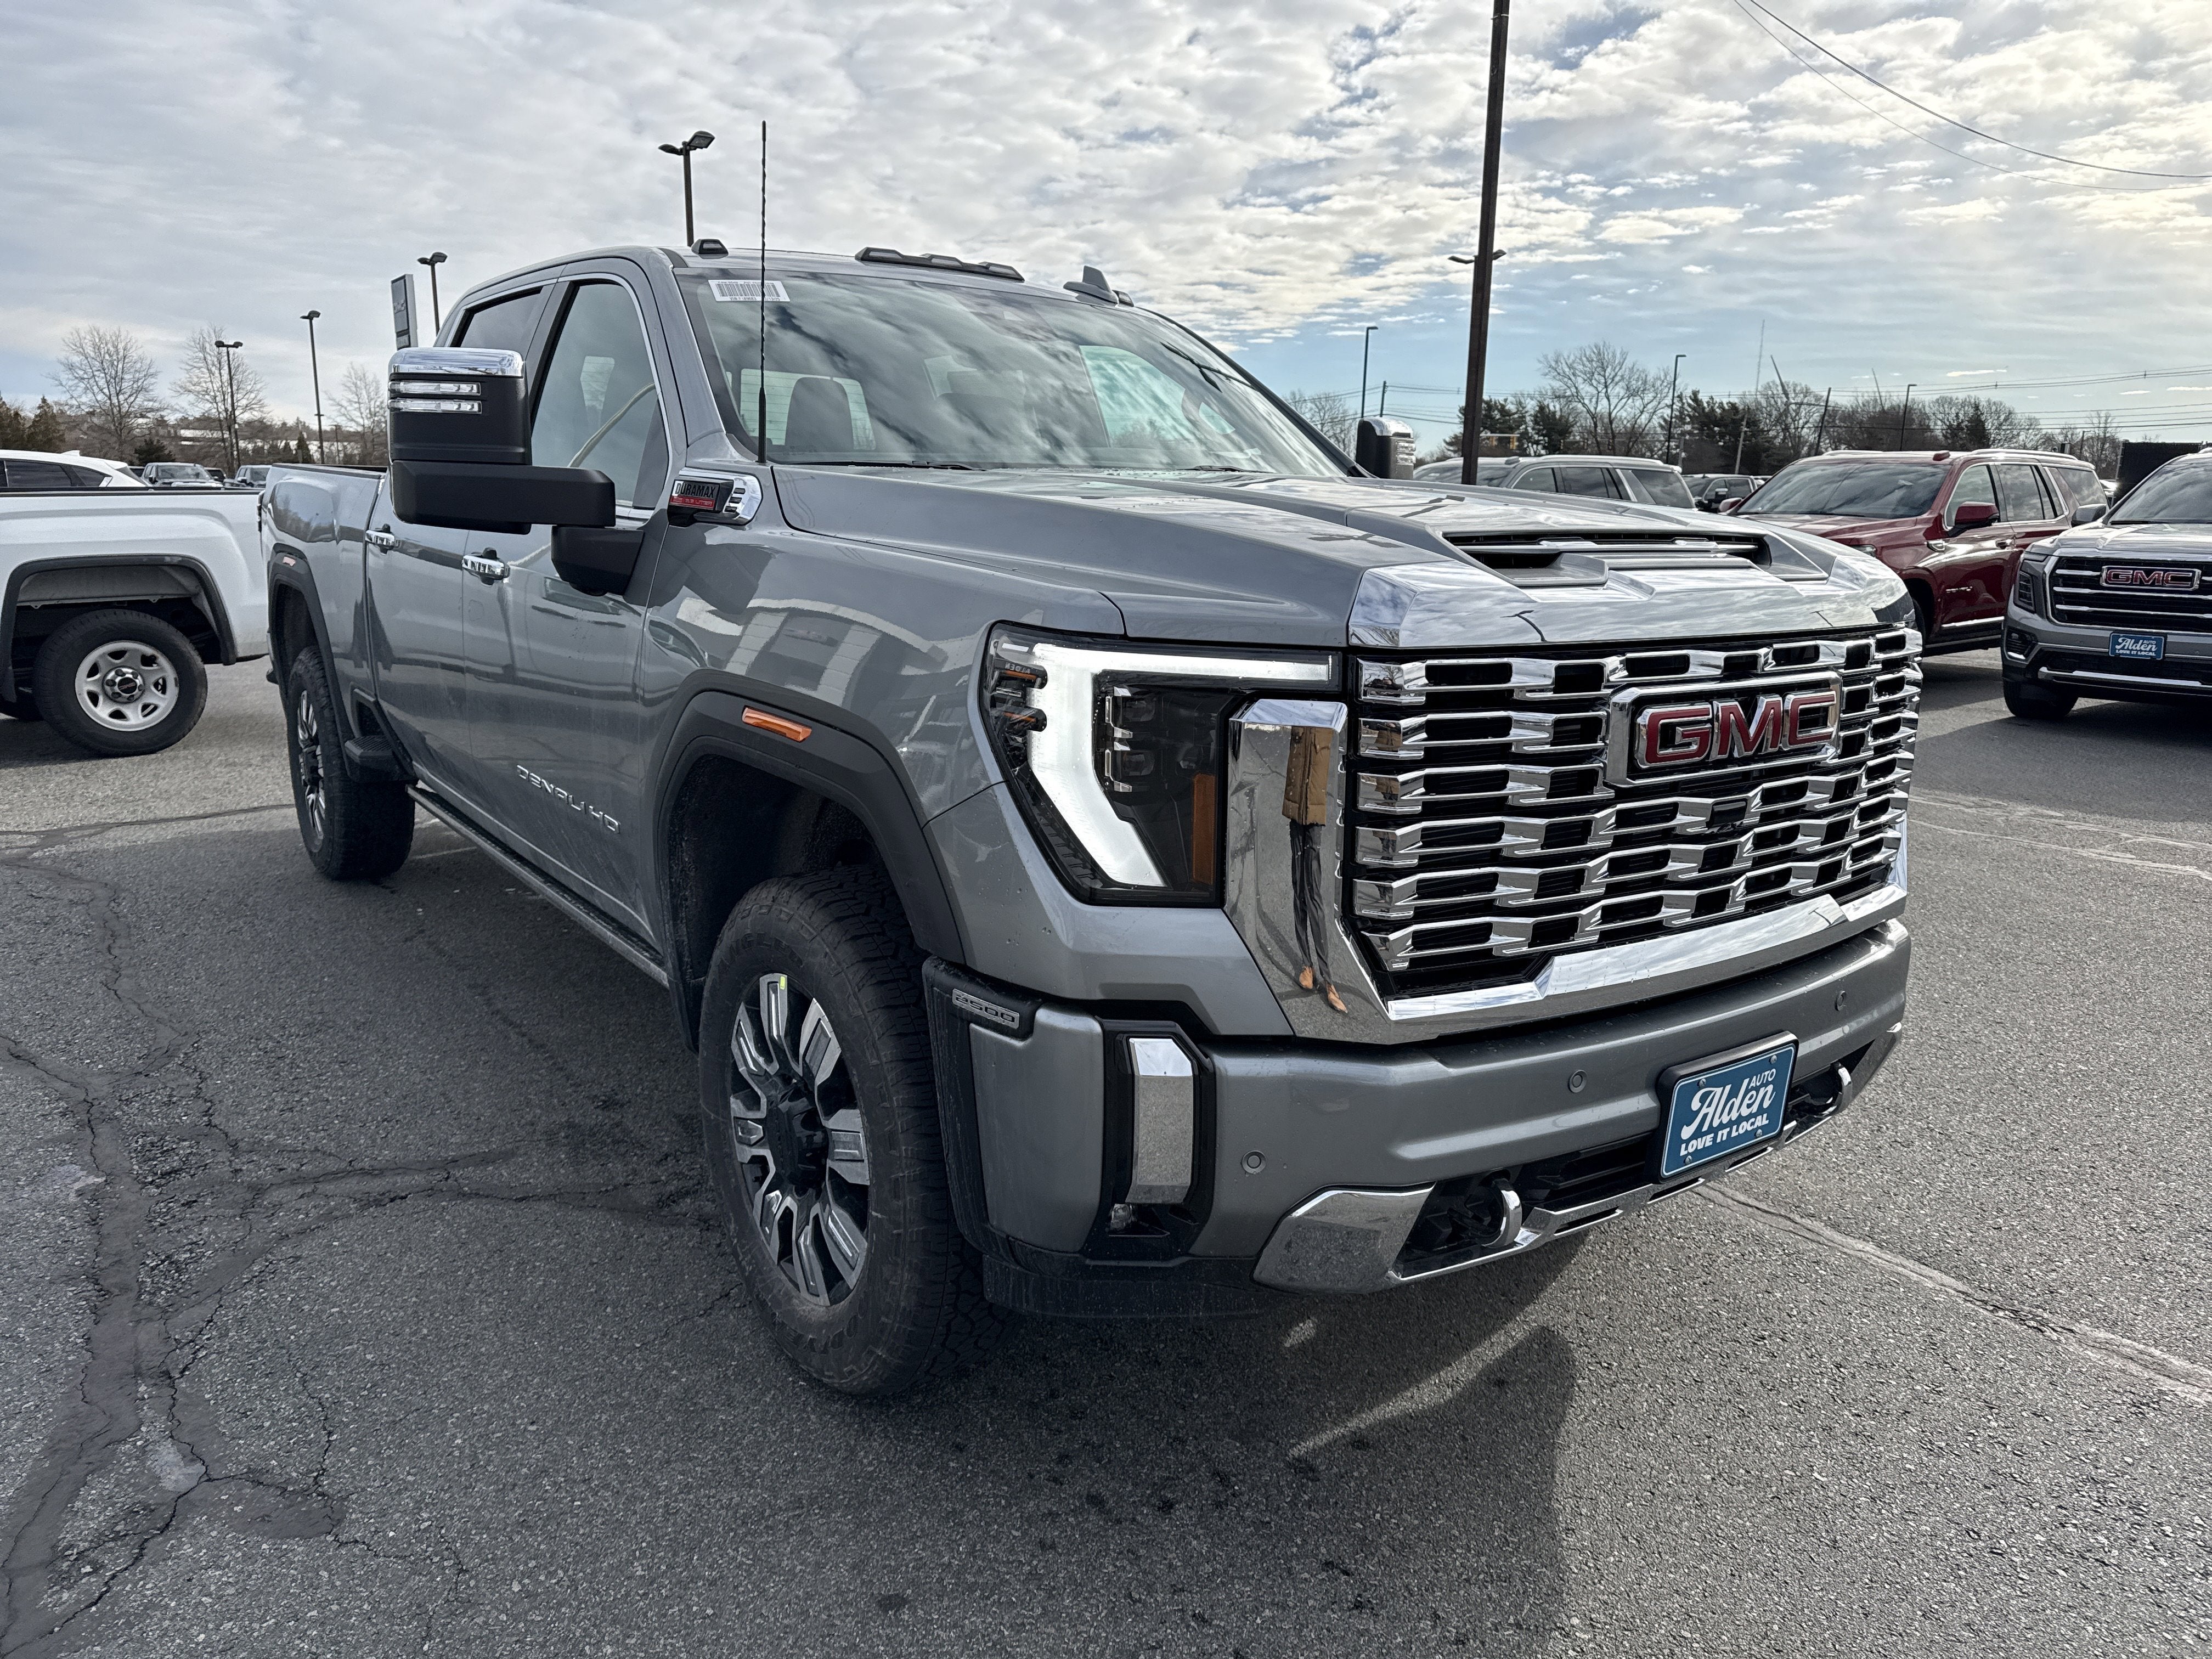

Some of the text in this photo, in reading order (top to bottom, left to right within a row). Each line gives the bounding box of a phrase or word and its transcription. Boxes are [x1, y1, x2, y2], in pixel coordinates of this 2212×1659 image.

[675, 483, 716, 498] DURAMAX
[2106, 569, 2193, 586] GMC
[2115, 637, 2158, 651] Alden
[1637, 689, 1837, 768] GMC
[517, 765, 621, 834] DENALI HD
[956, 994, 1015, 1023] 2500
[1748, 1069, 1776, 1089] AUTO
[1681, 1078, 1776, 1140] Alden
[1680, 1113, 1769, 1156] LOVE IT LOCAL
